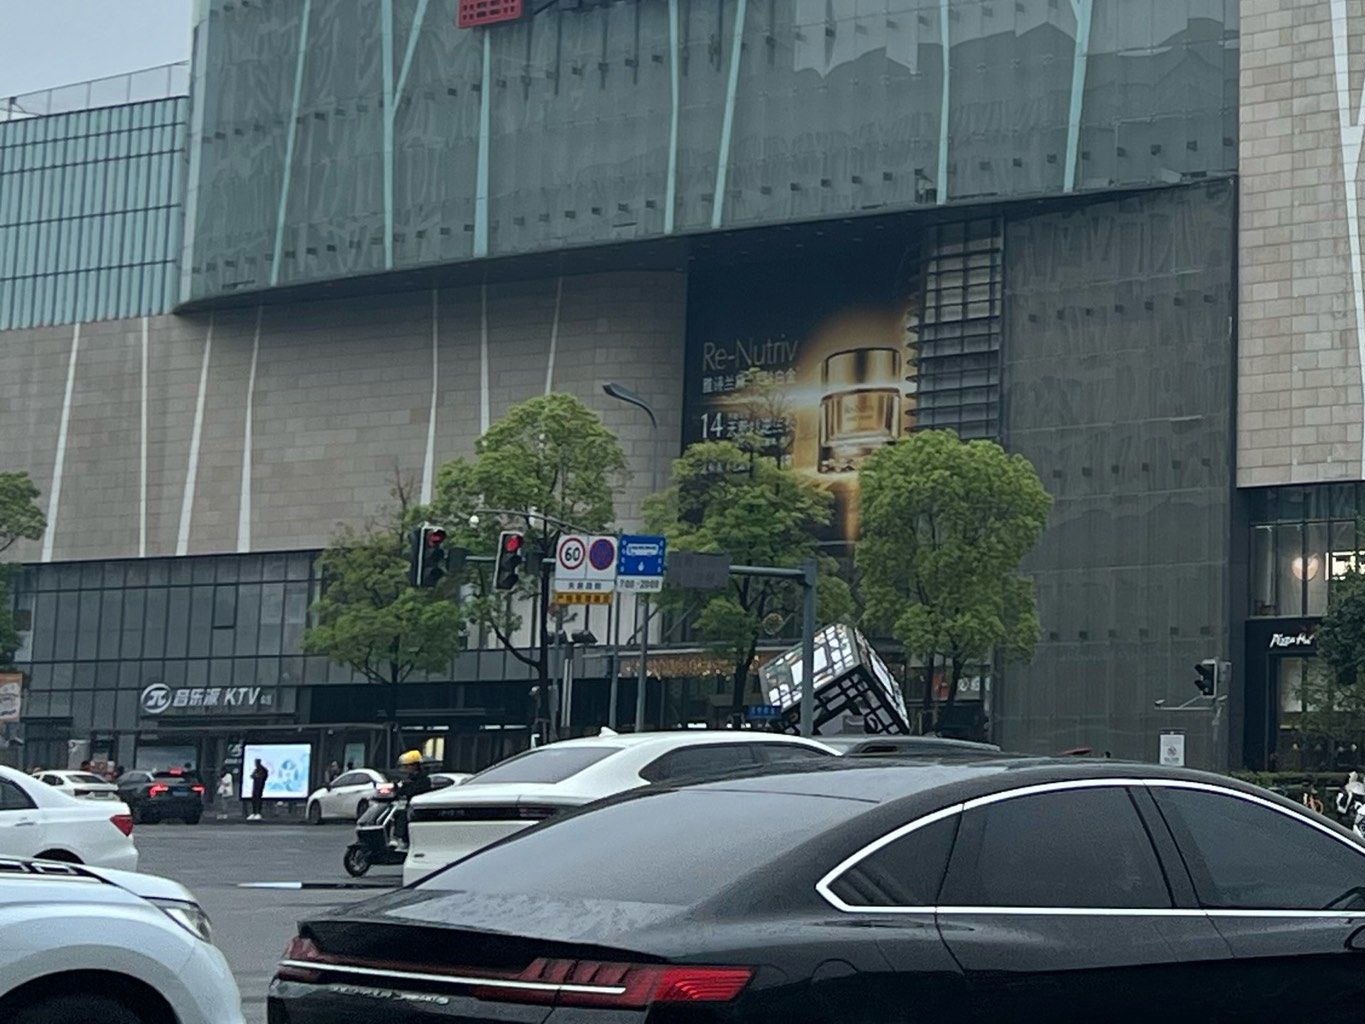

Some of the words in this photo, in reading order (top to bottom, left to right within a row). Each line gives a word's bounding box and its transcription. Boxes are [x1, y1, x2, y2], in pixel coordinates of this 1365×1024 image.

[702, 333, 799, 371] Re-Nutriv
[564, 546, 581, 562] 60
[1269, 632, 1296, 649] Pizza
[224, 687, 261, 706] KTV
